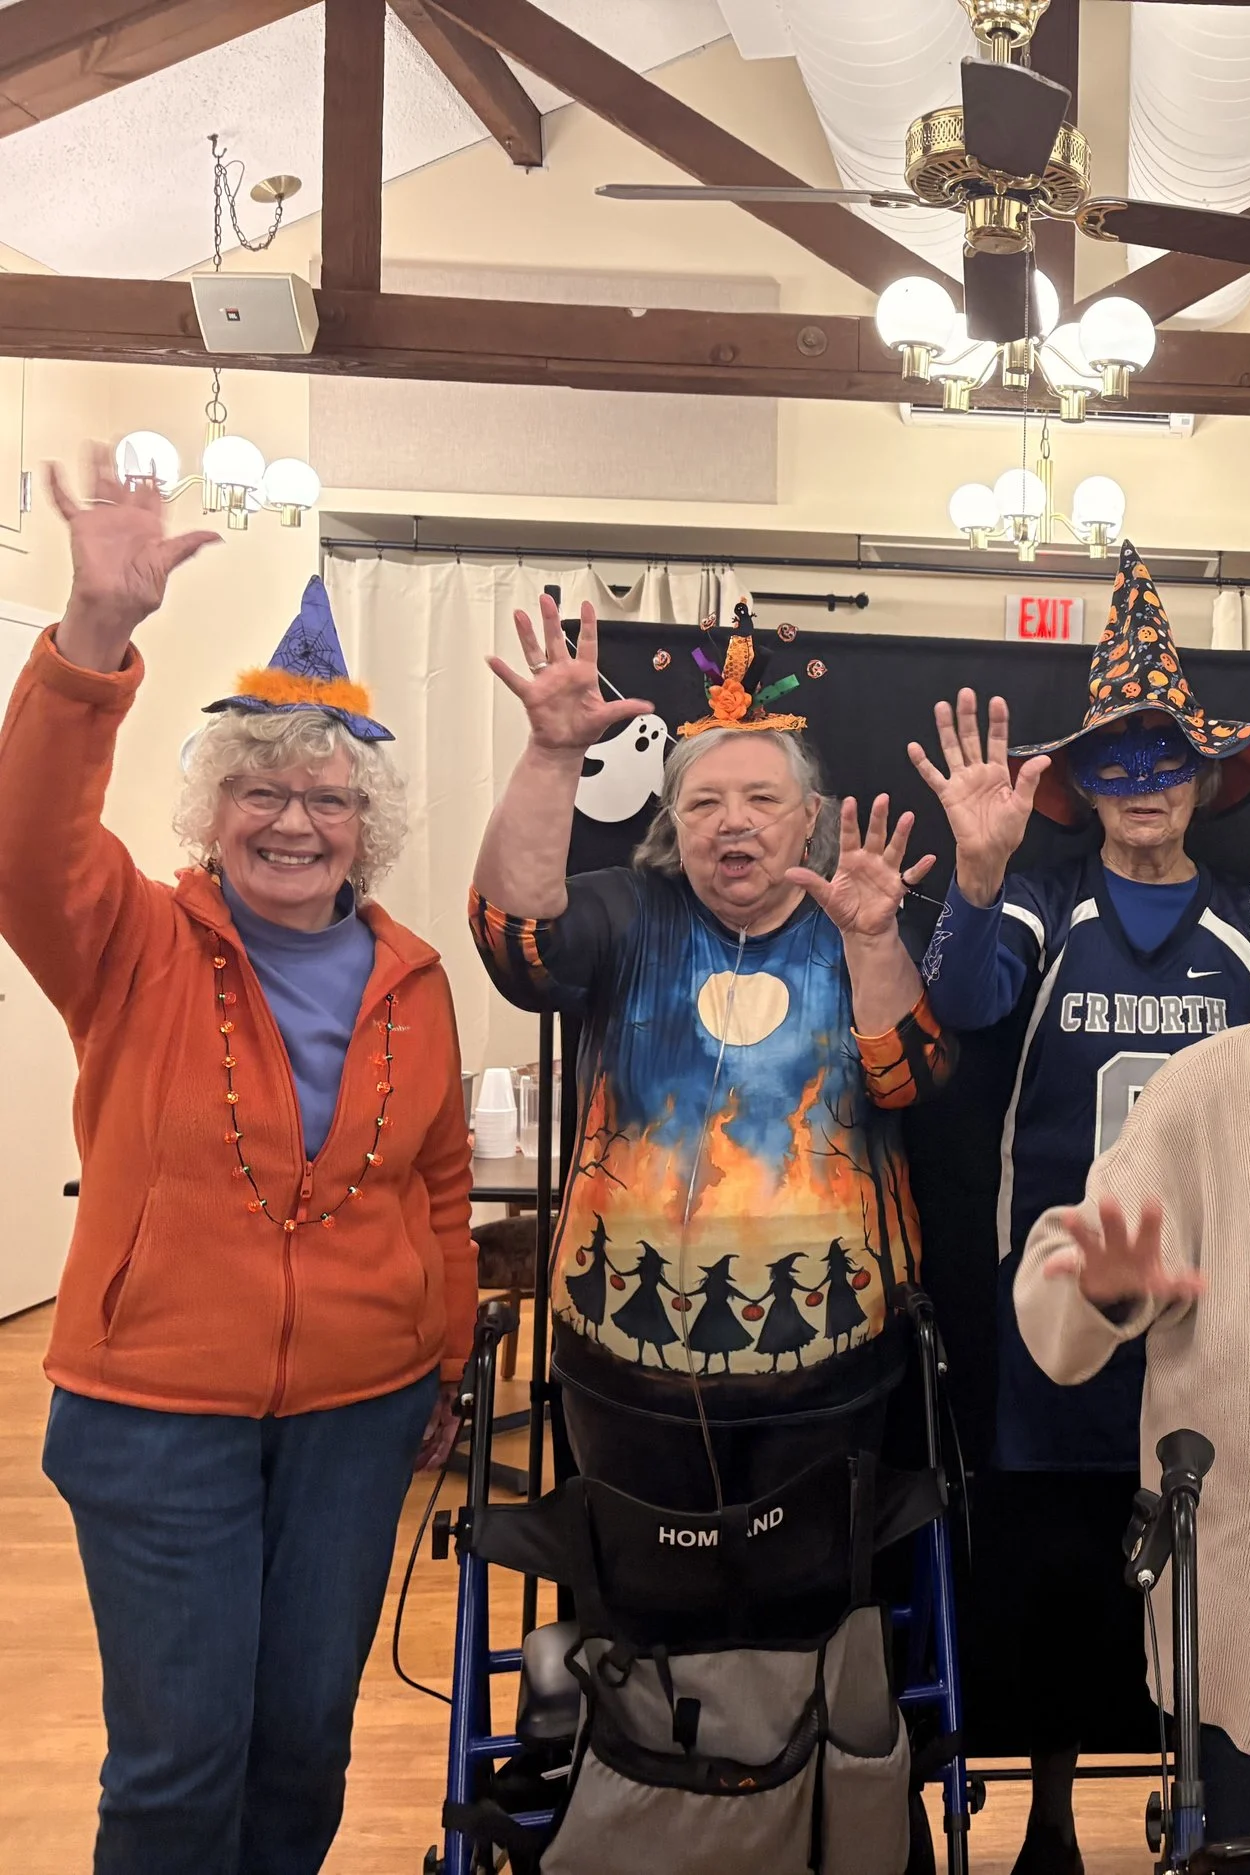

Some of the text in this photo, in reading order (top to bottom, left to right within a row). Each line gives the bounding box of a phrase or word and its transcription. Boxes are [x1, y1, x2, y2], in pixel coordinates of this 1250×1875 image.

[1019, 597, 1073, 640] EXIT
[1060, 992, 1228, 1034] CR NORTH
